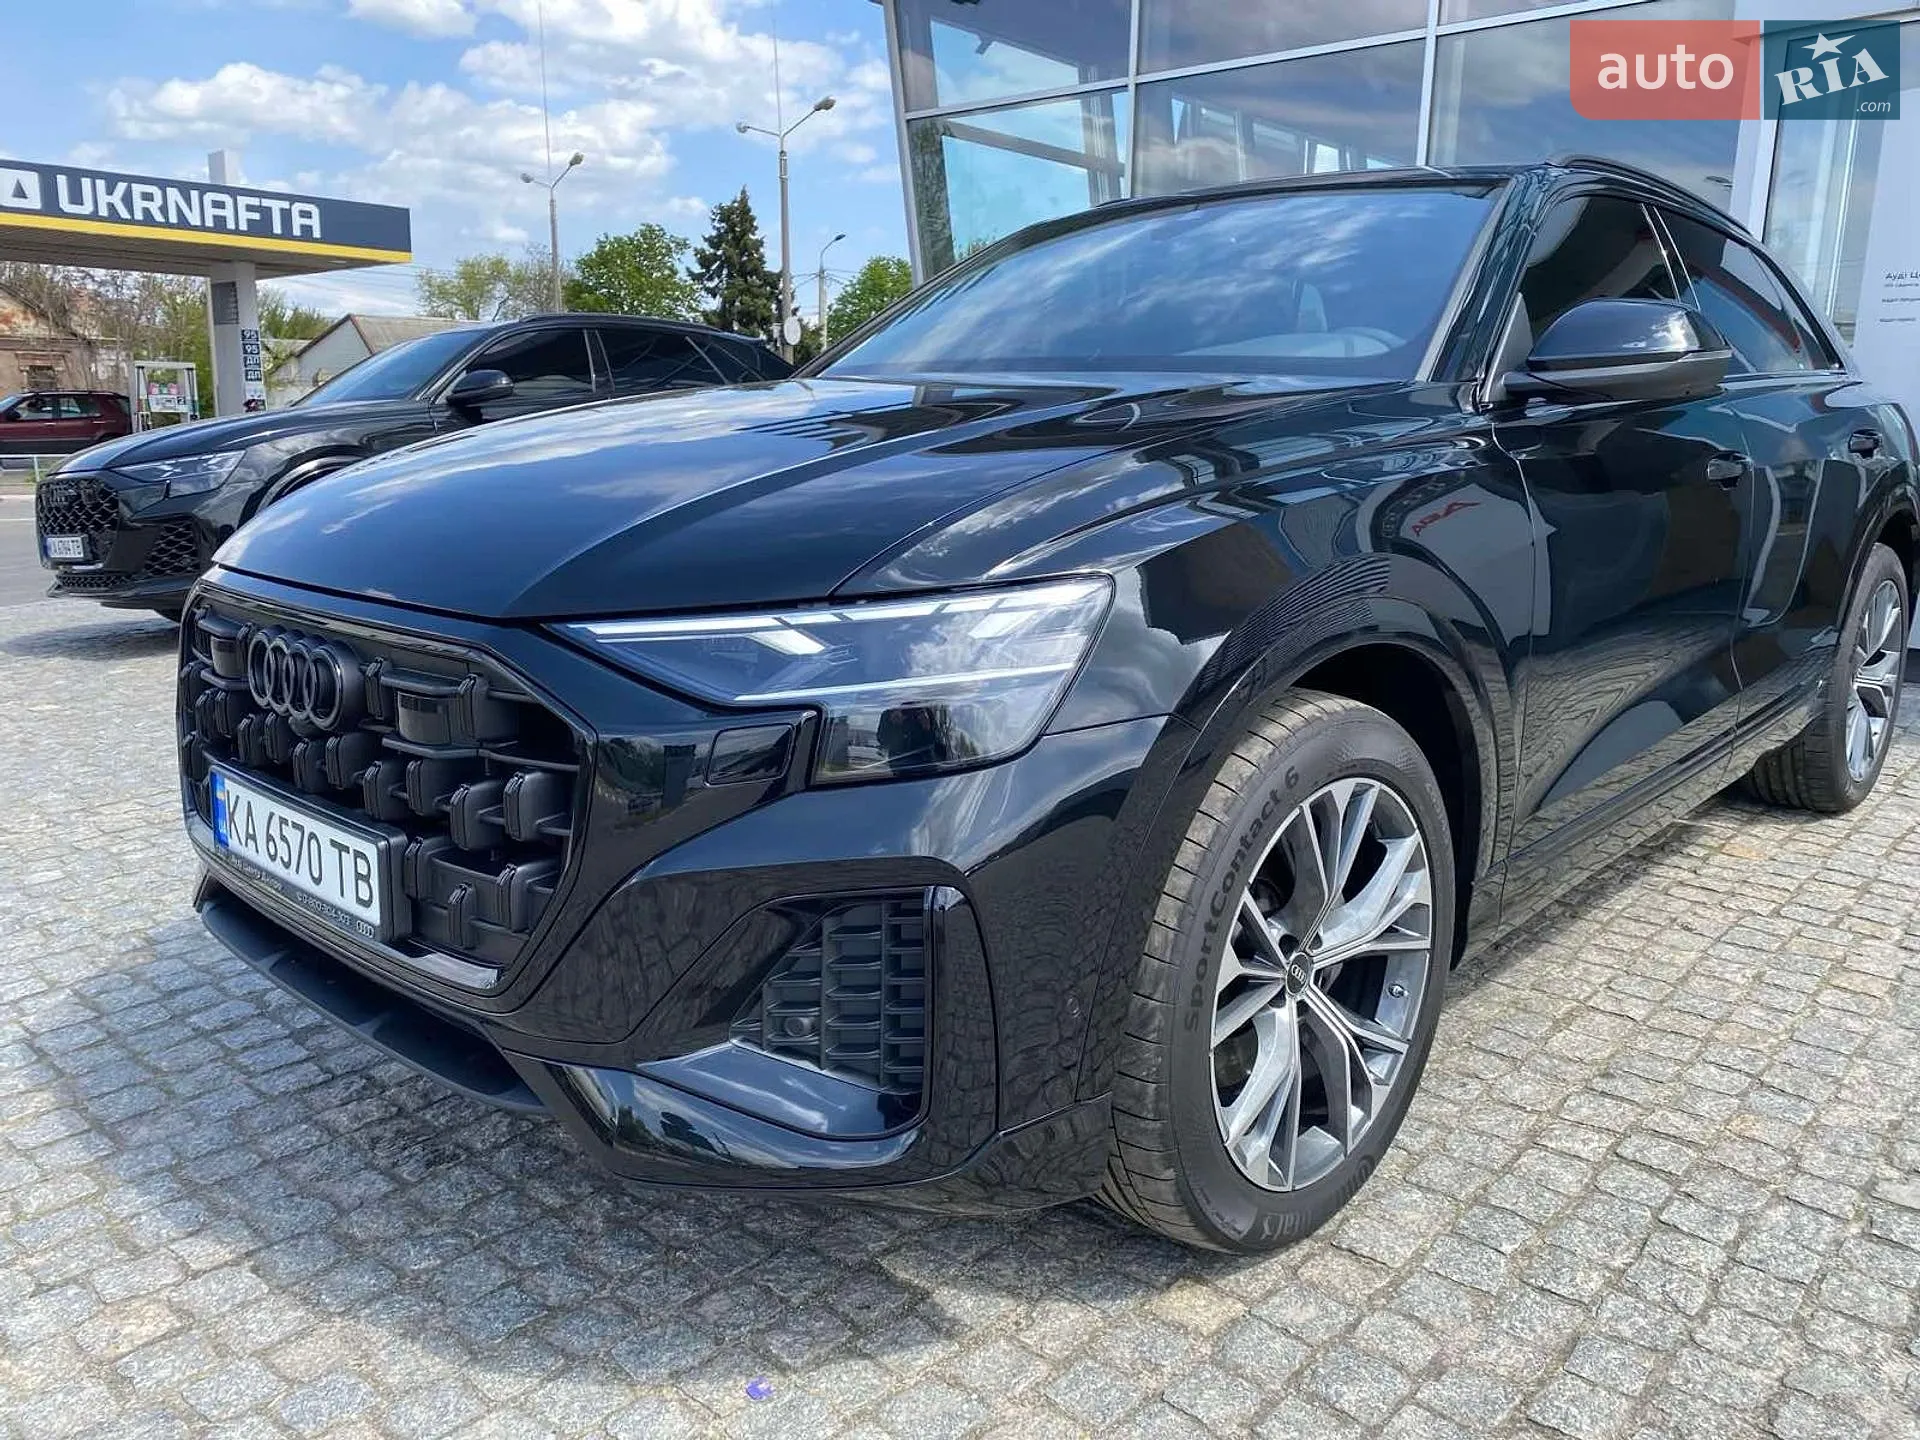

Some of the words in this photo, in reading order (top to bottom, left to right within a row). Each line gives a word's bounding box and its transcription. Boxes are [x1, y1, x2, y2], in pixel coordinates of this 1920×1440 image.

[56, 173, 322, 239] UKRNAFTA
[226, 789, 260, 854] KA
[266, 811, 323, 886] 6570
[329, 837, 374, 909] TB
[1184, 788, 1280, 1032] SportContact
[1284, 765, 1300, 789] 6
